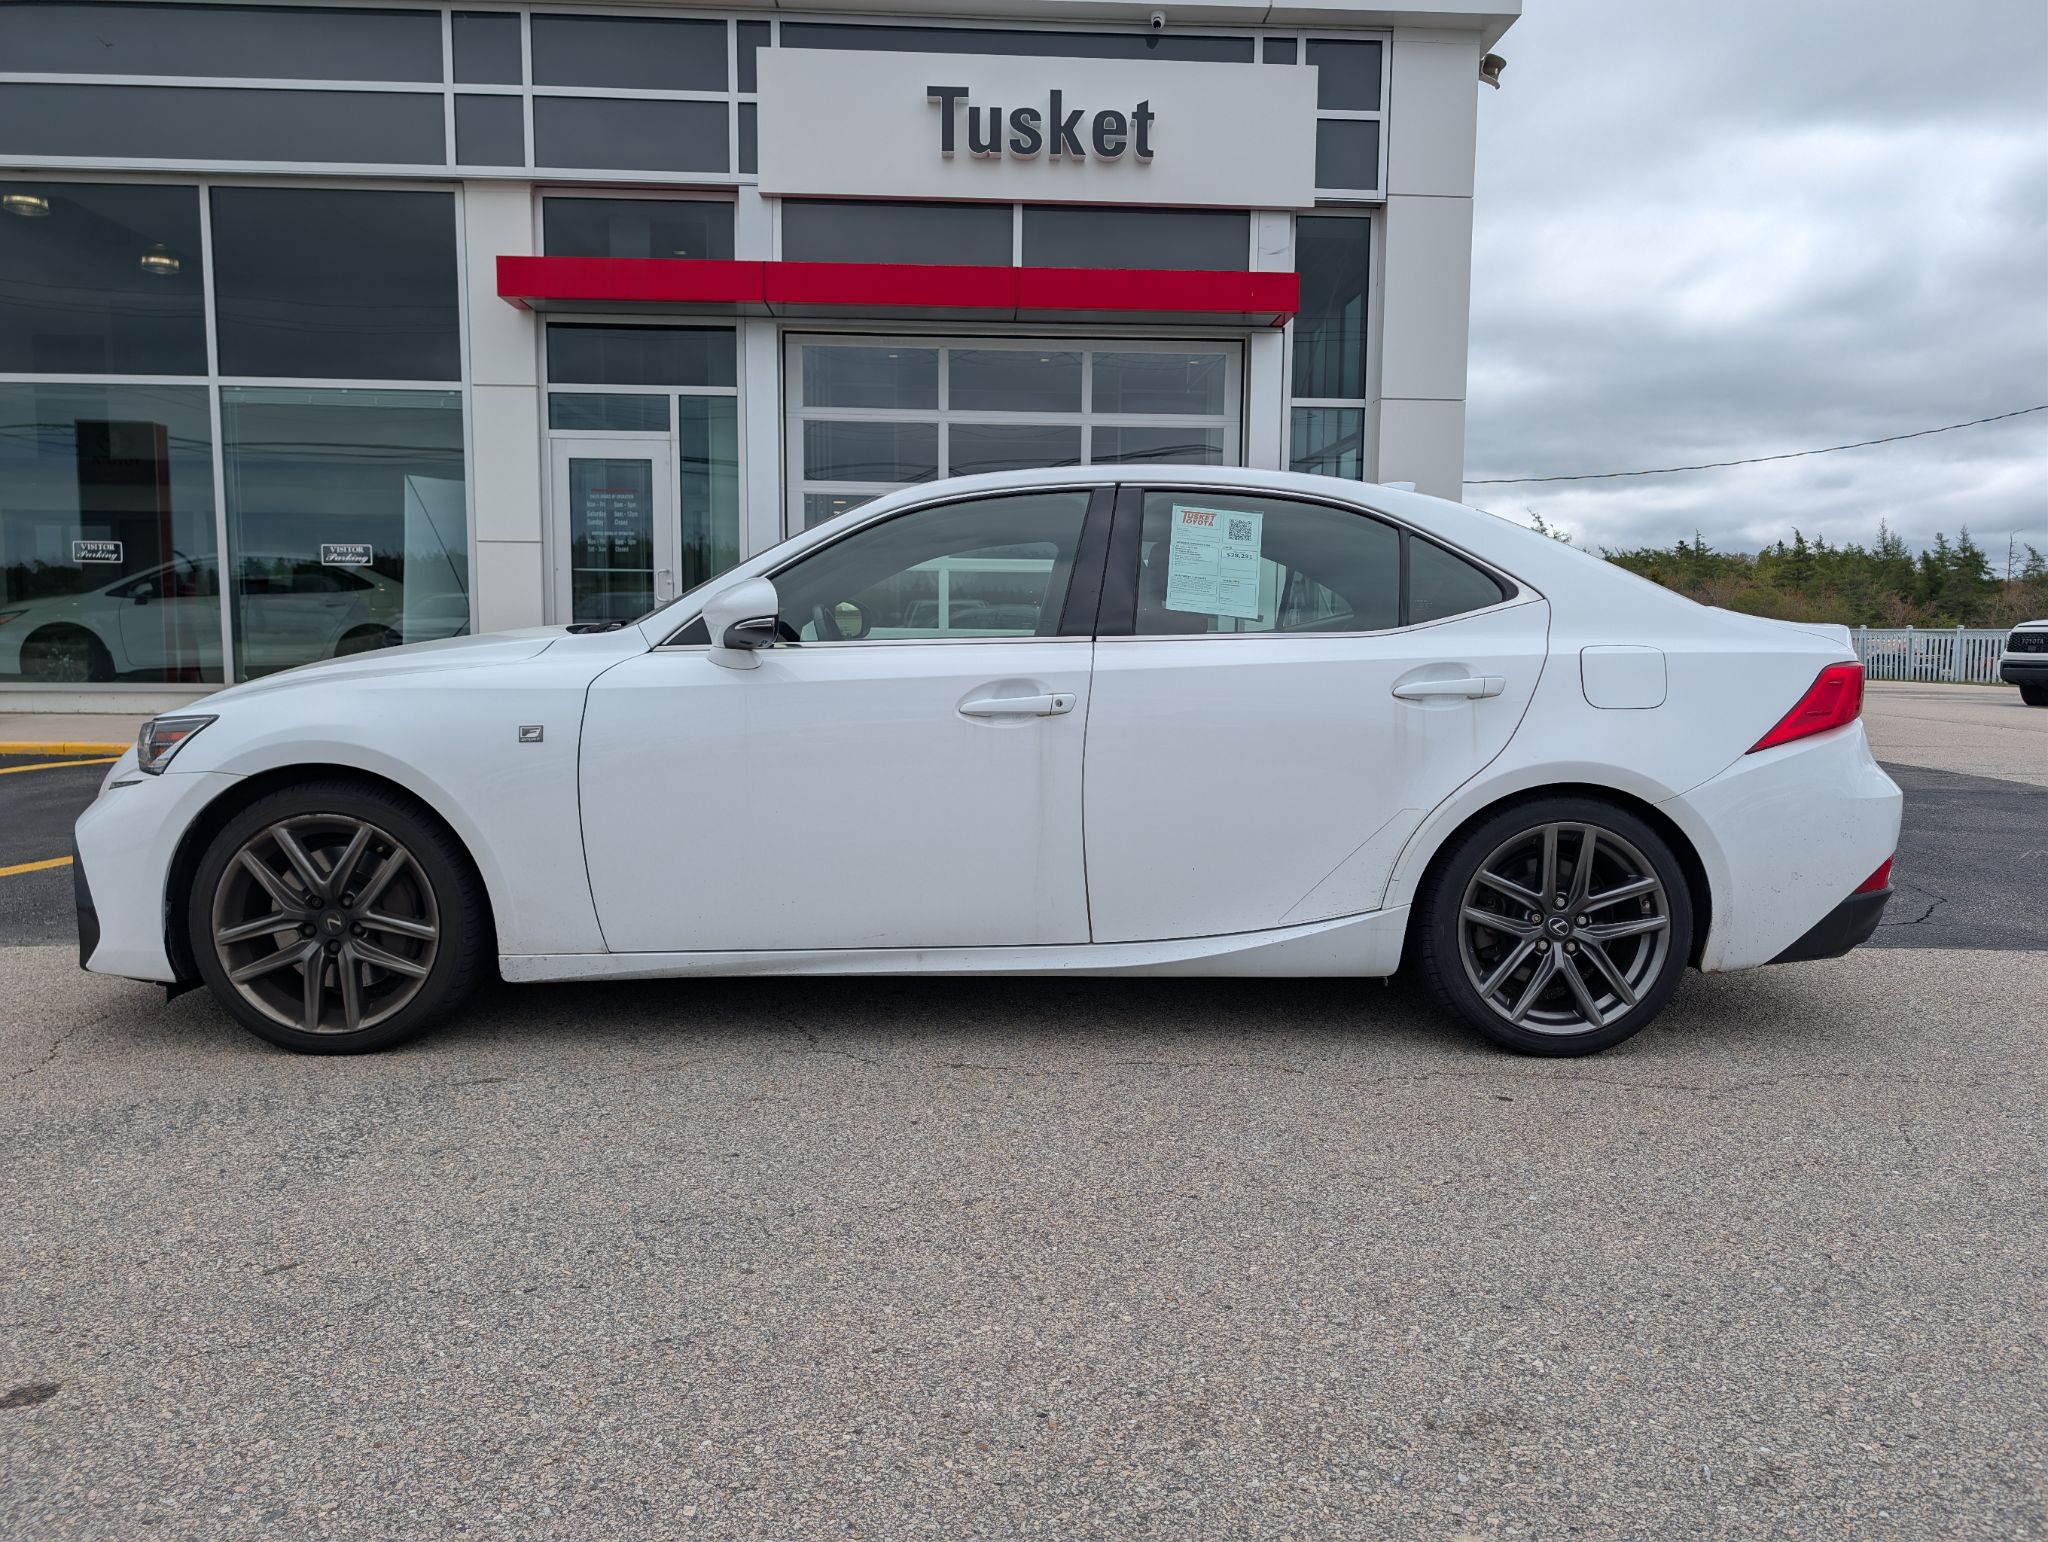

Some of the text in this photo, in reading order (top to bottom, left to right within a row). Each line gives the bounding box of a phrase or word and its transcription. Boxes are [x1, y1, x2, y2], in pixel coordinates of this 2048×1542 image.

[927, 85, 1155, 165] Tusket
[76, 550, 118, 560] Parking
[325, 553, 368, 564] Parking
